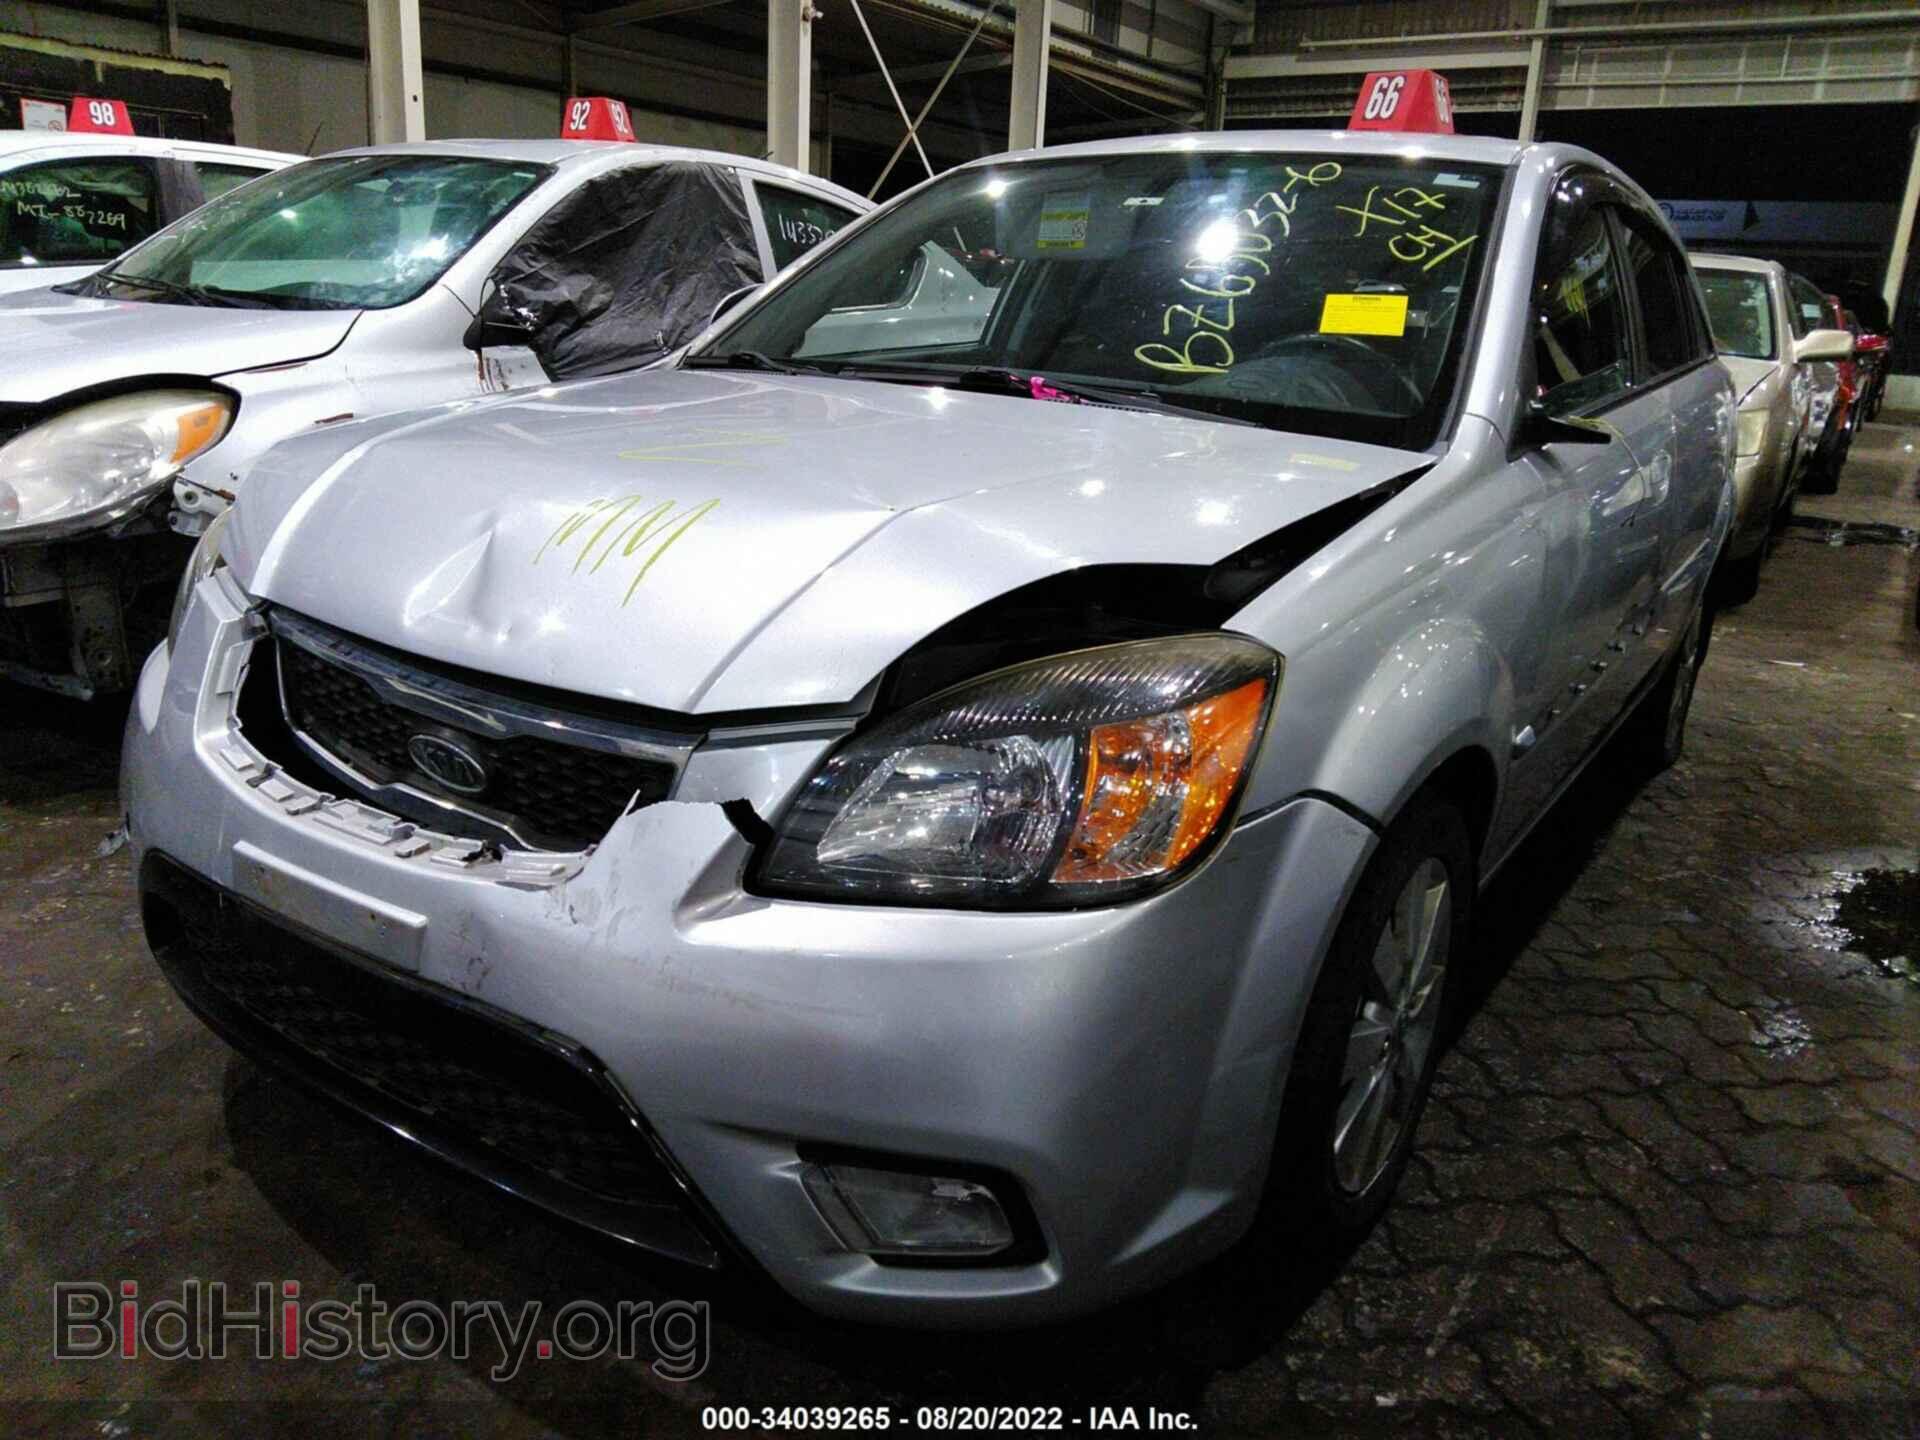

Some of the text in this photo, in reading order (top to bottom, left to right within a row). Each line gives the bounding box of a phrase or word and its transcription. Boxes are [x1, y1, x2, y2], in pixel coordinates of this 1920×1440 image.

[1364, 76, 1405, 120] 66
[89, 101, 115, 126] 98
[570, 101, 591, 130] 92
